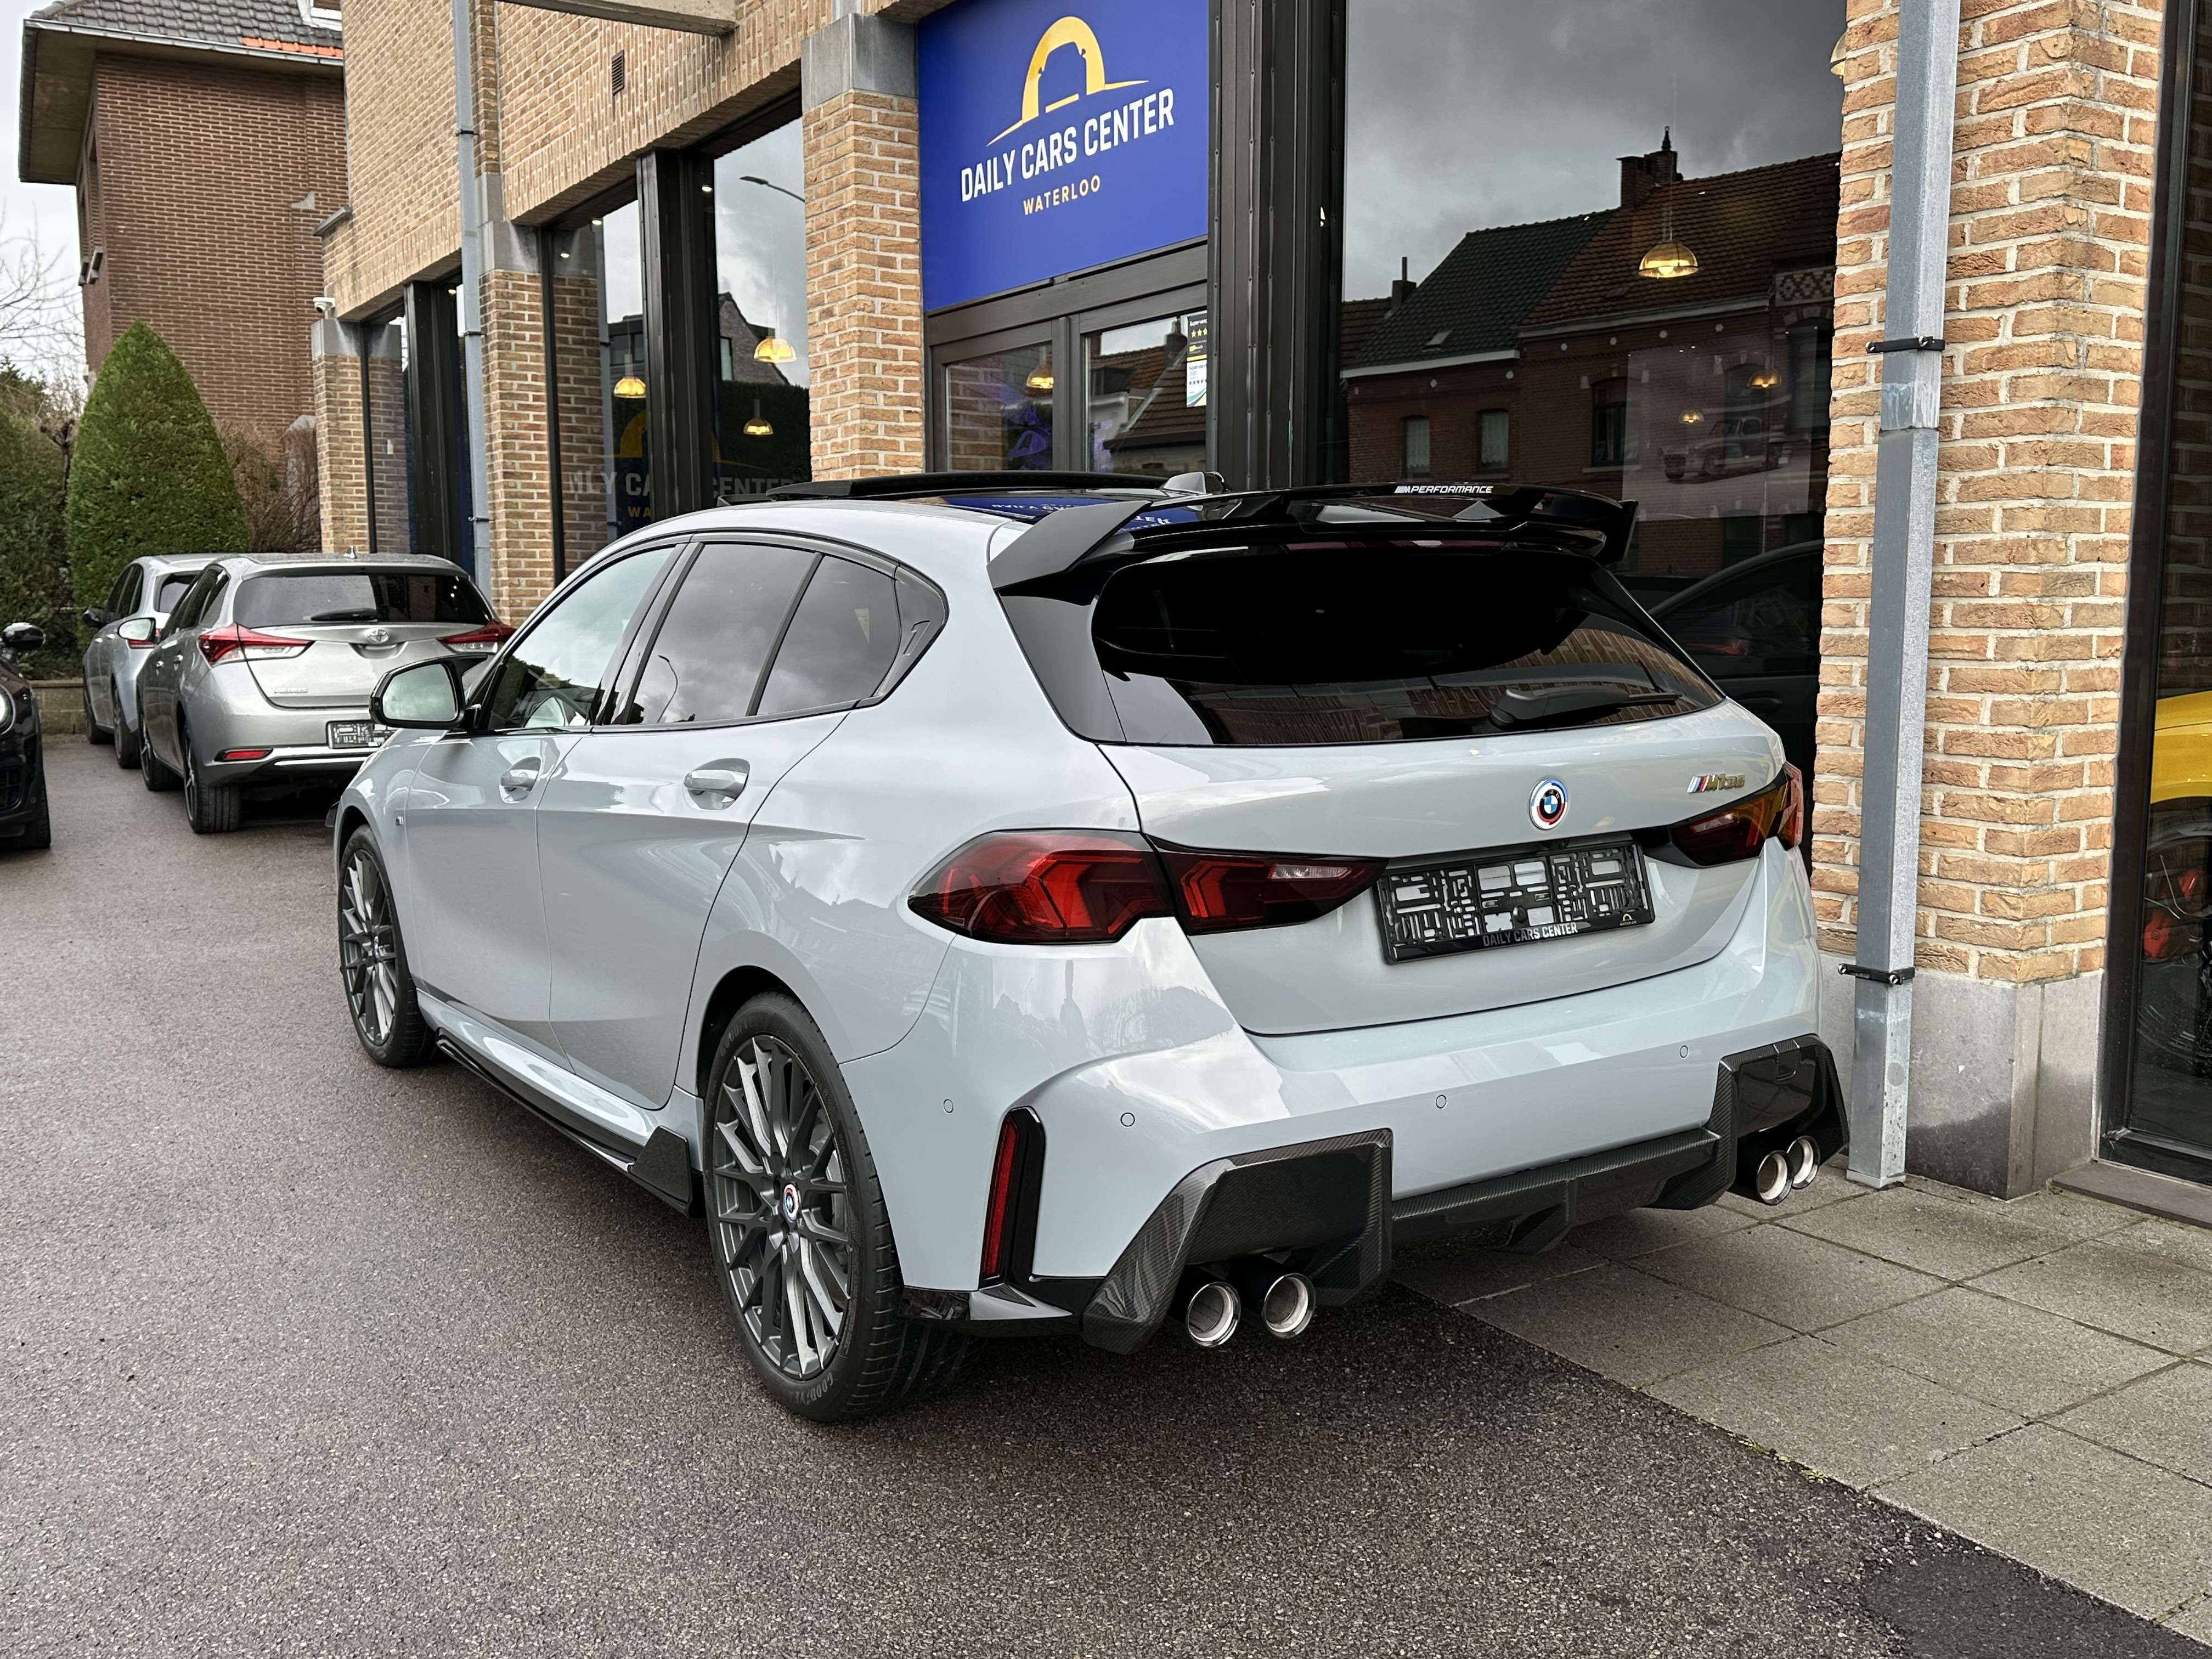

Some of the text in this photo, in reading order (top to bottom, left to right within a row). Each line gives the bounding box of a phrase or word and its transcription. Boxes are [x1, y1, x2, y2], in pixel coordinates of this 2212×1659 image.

[961, 88, 1174, 202] DAILY CARS CENTER
[1023, 175, 1101, 216] WATERLOO
[1483, 922, 1578, 946] DAILY CARS CENTER
